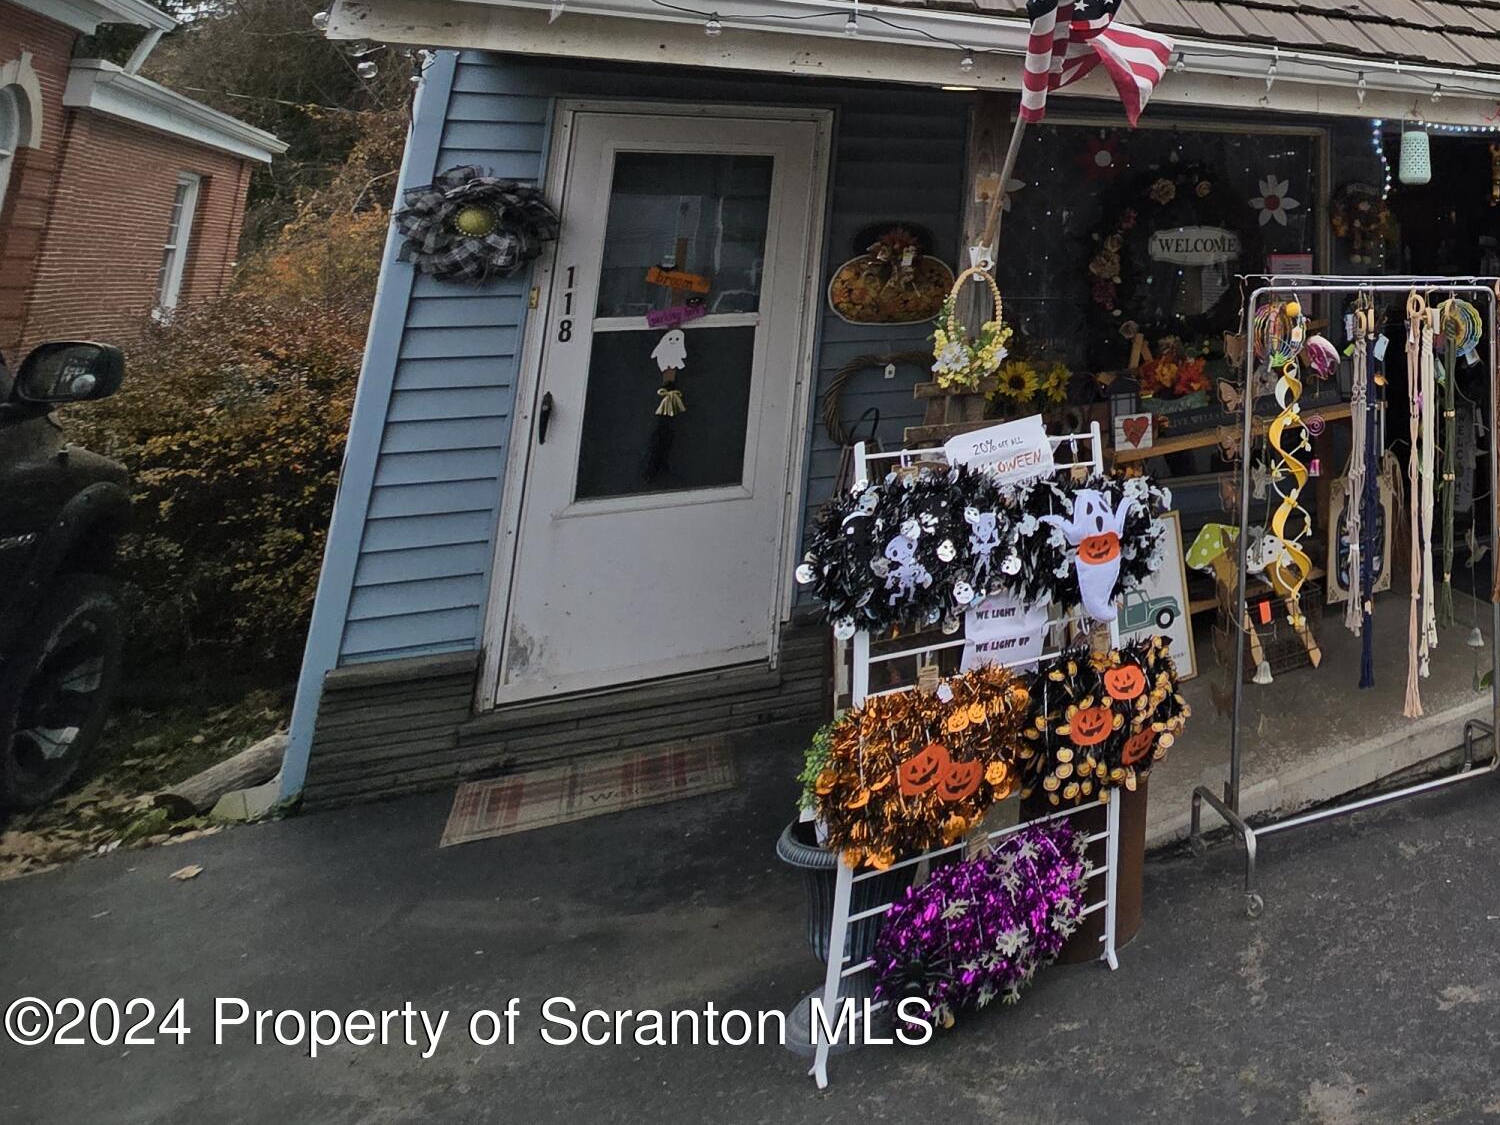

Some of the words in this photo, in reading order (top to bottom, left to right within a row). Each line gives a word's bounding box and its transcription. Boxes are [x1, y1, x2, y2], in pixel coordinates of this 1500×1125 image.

[1158, 237, 1237, 254] WELCOME
[557, 265, 575, 343] 118
[972, 439, 998, 456] 20%
[1010, 436, 1024, 446] ALL
[996, 448, 1042, 474] OWEEN
[976, 609, 990, 621] WE
[991, 607, 1017, 619] LIGHT
[975, 641, 989, 654] WE
[990, 638, 1017, 651] LIGHT
[1018, 636, 1031, 647] UP
